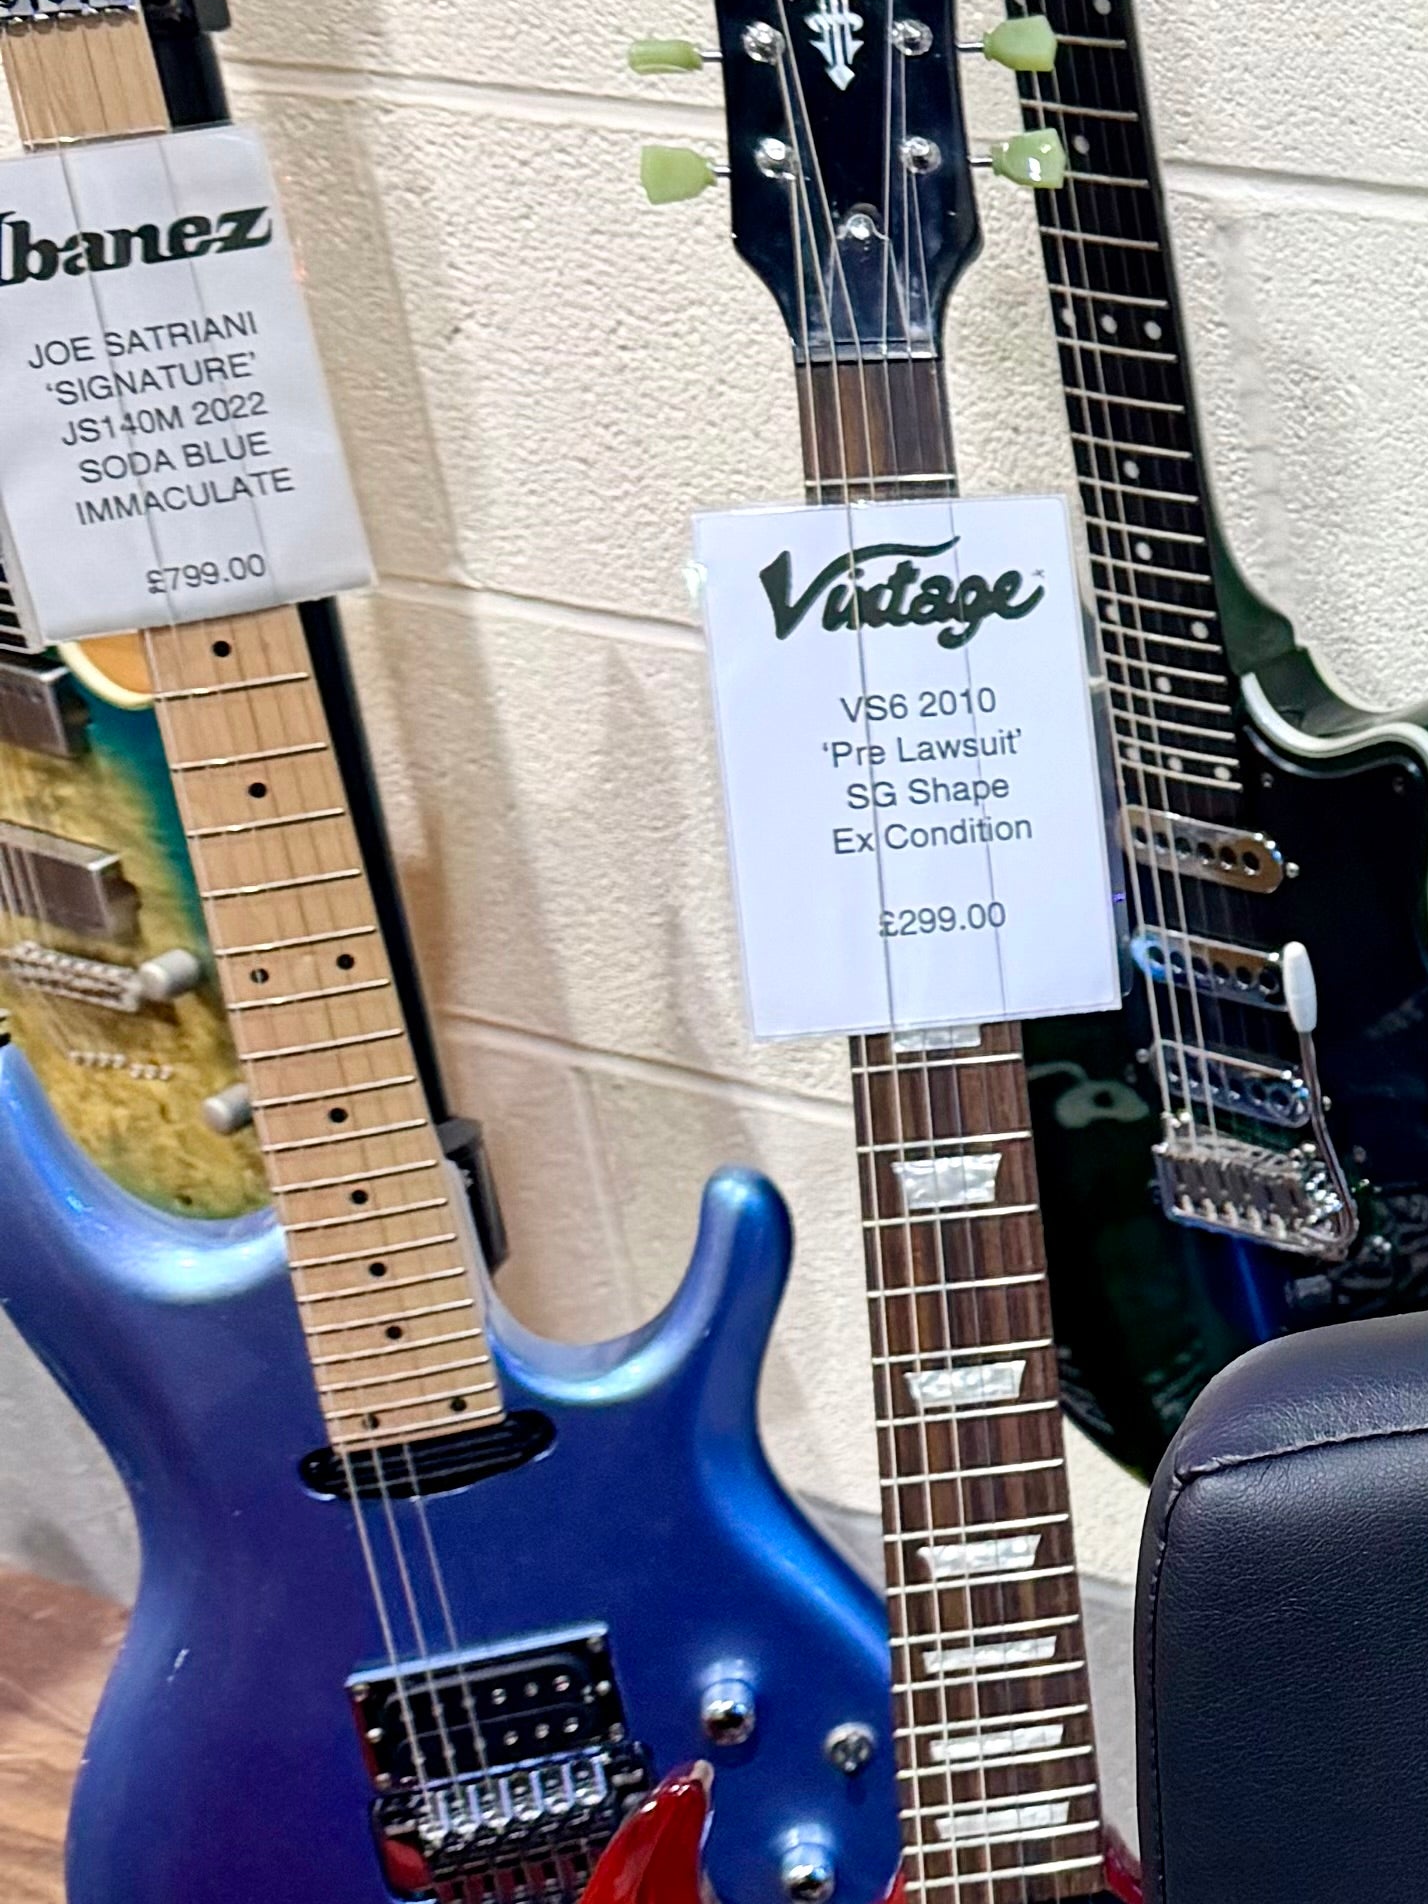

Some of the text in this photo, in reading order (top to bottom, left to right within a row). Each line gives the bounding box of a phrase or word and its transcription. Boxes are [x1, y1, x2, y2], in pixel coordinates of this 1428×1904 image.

[28, 310, 258, 370] JOE SATRIANI
[62, 391, 268, 447] JS140M 2022
[80, 431, 271, 484] SODA BLUE
[75, 468, 294, 526] IMMACULATE
[147, 554, 266, 595] £799.00
[759, 536, 1045, 650] Vintage
[840, 687, 996, 724] VS6 2010
[846, 777, 1010, 810] SG Shape
[832, 816, 1034, 855] Ex Condition
[878, 902, 1006, 937] £299.00
